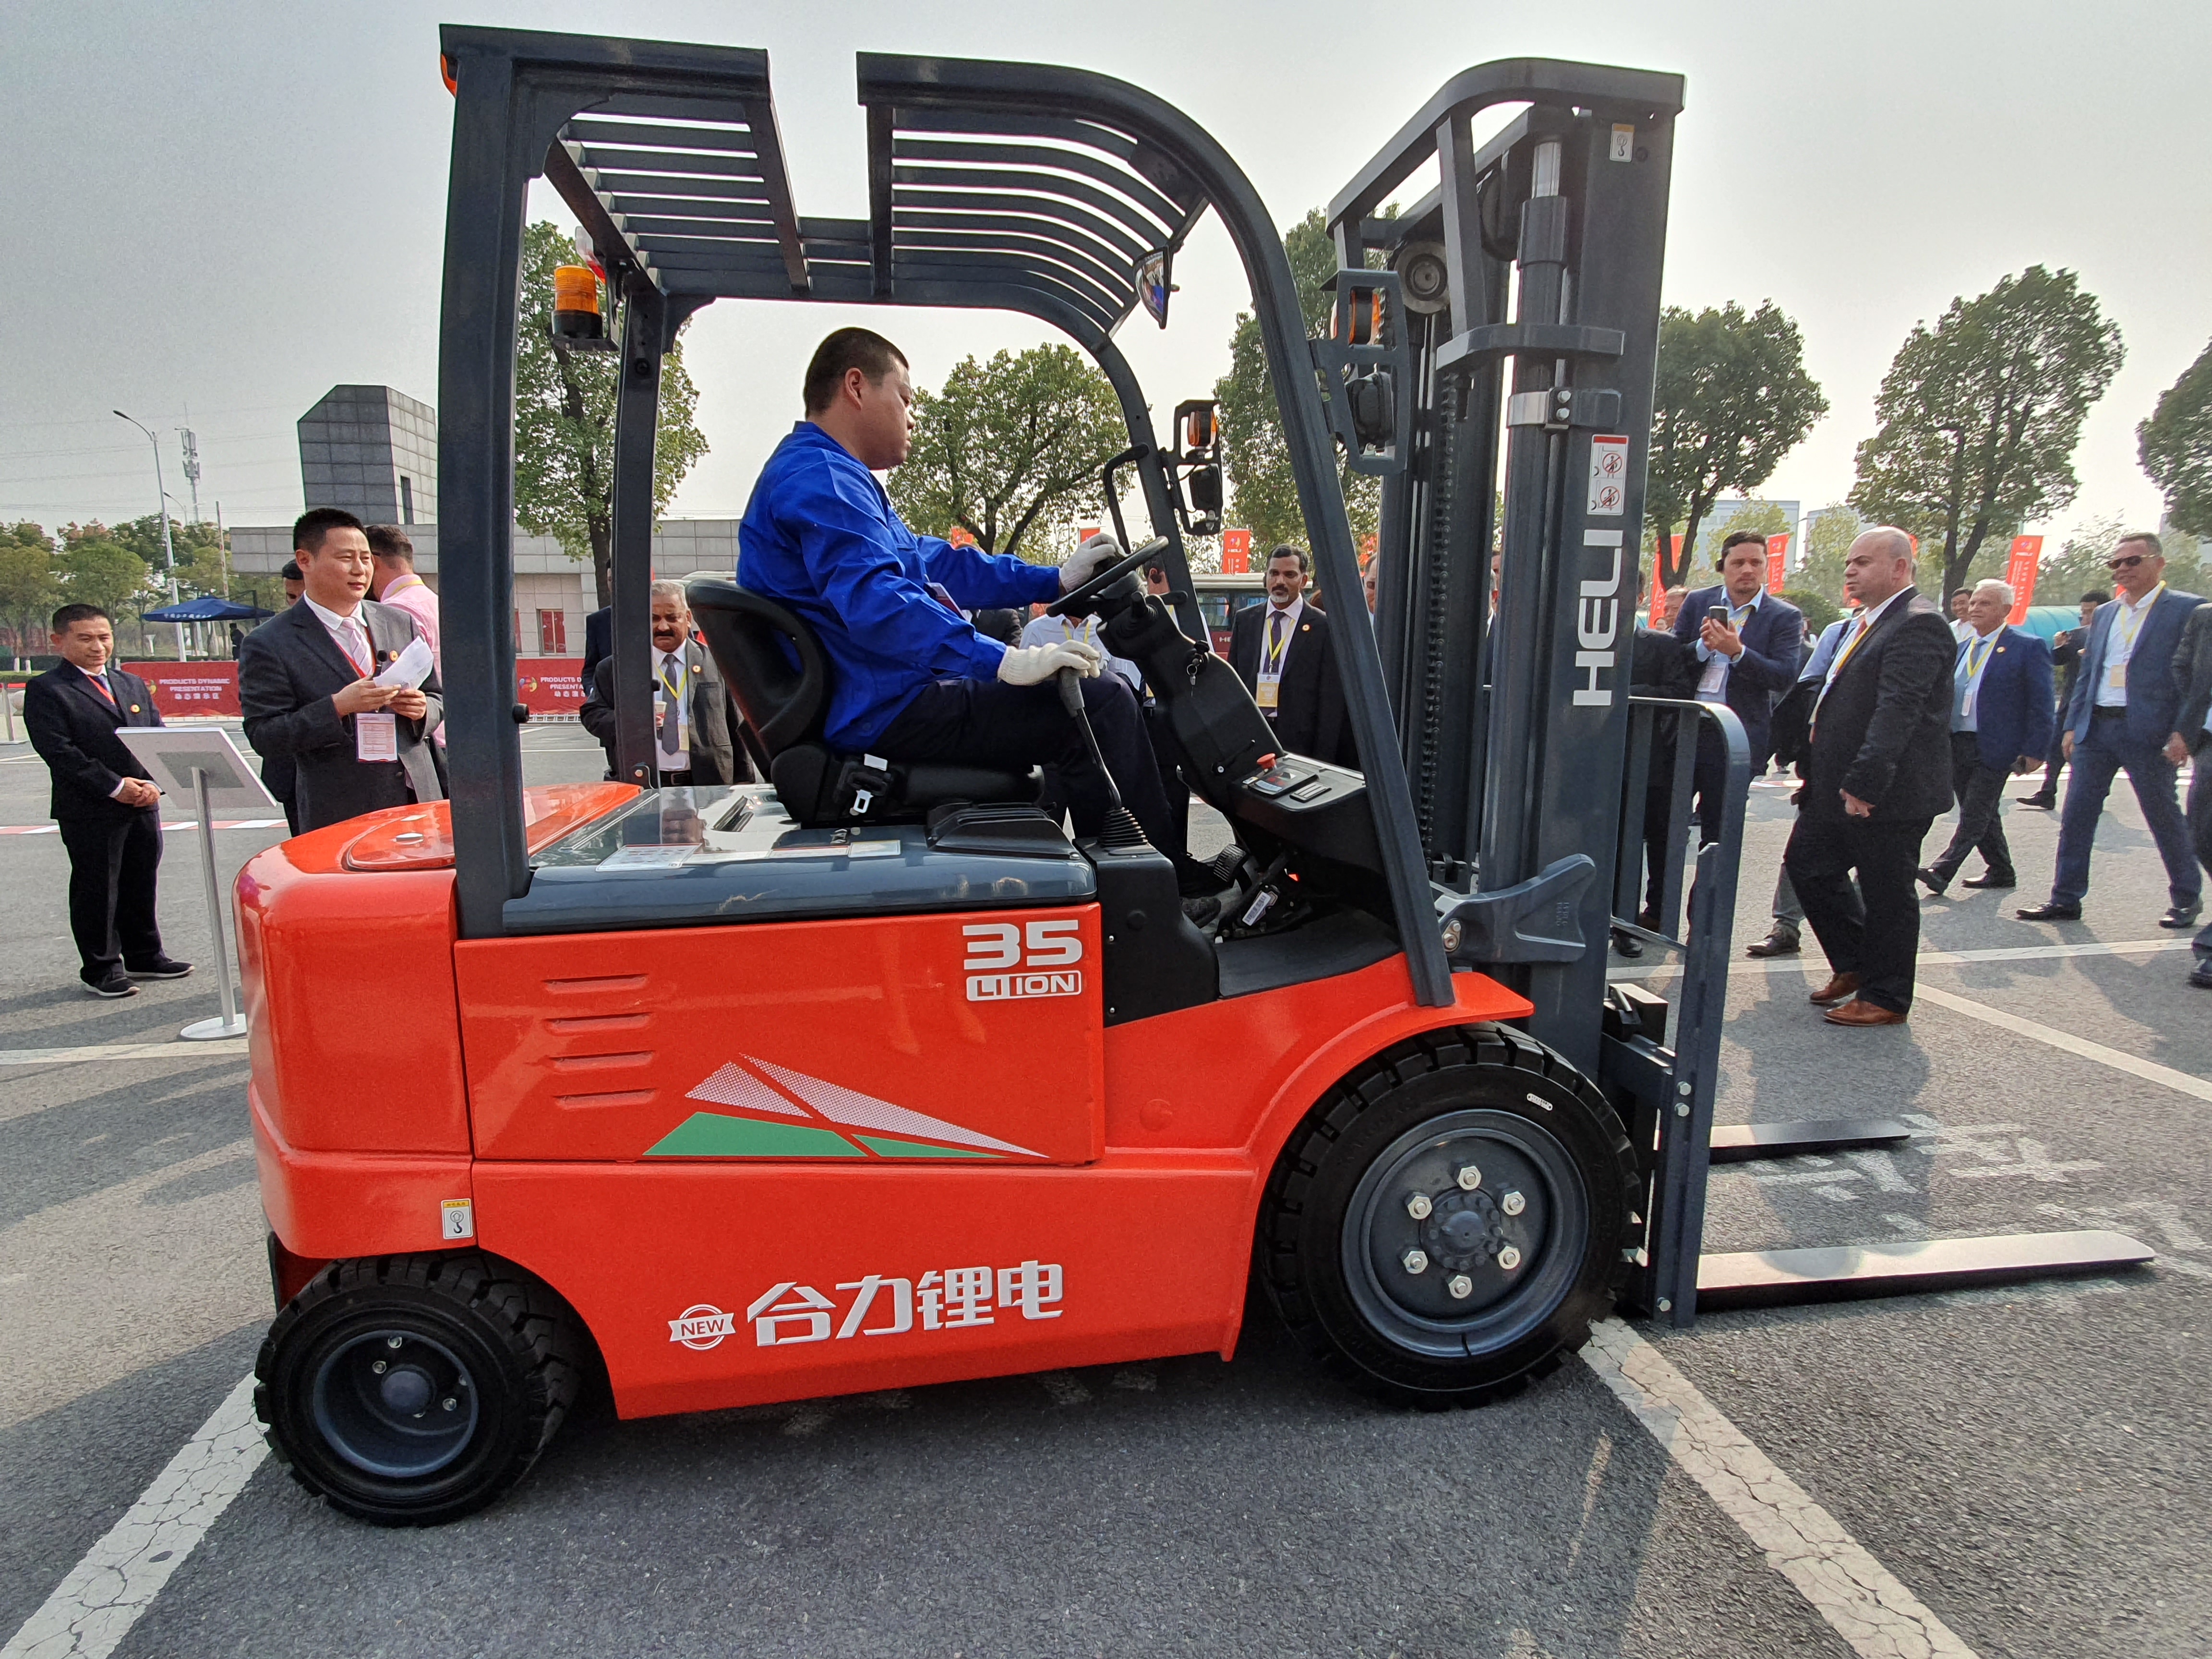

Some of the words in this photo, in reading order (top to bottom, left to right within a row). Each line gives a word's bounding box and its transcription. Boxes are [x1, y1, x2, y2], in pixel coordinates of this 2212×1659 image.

[1573, 529, 1624, 706] HELI
[962, 919, 1082, 970] 35
[680, 1318, 724, 1337] NEW
[746, 1260, 1063, 1347] 合力锂电
